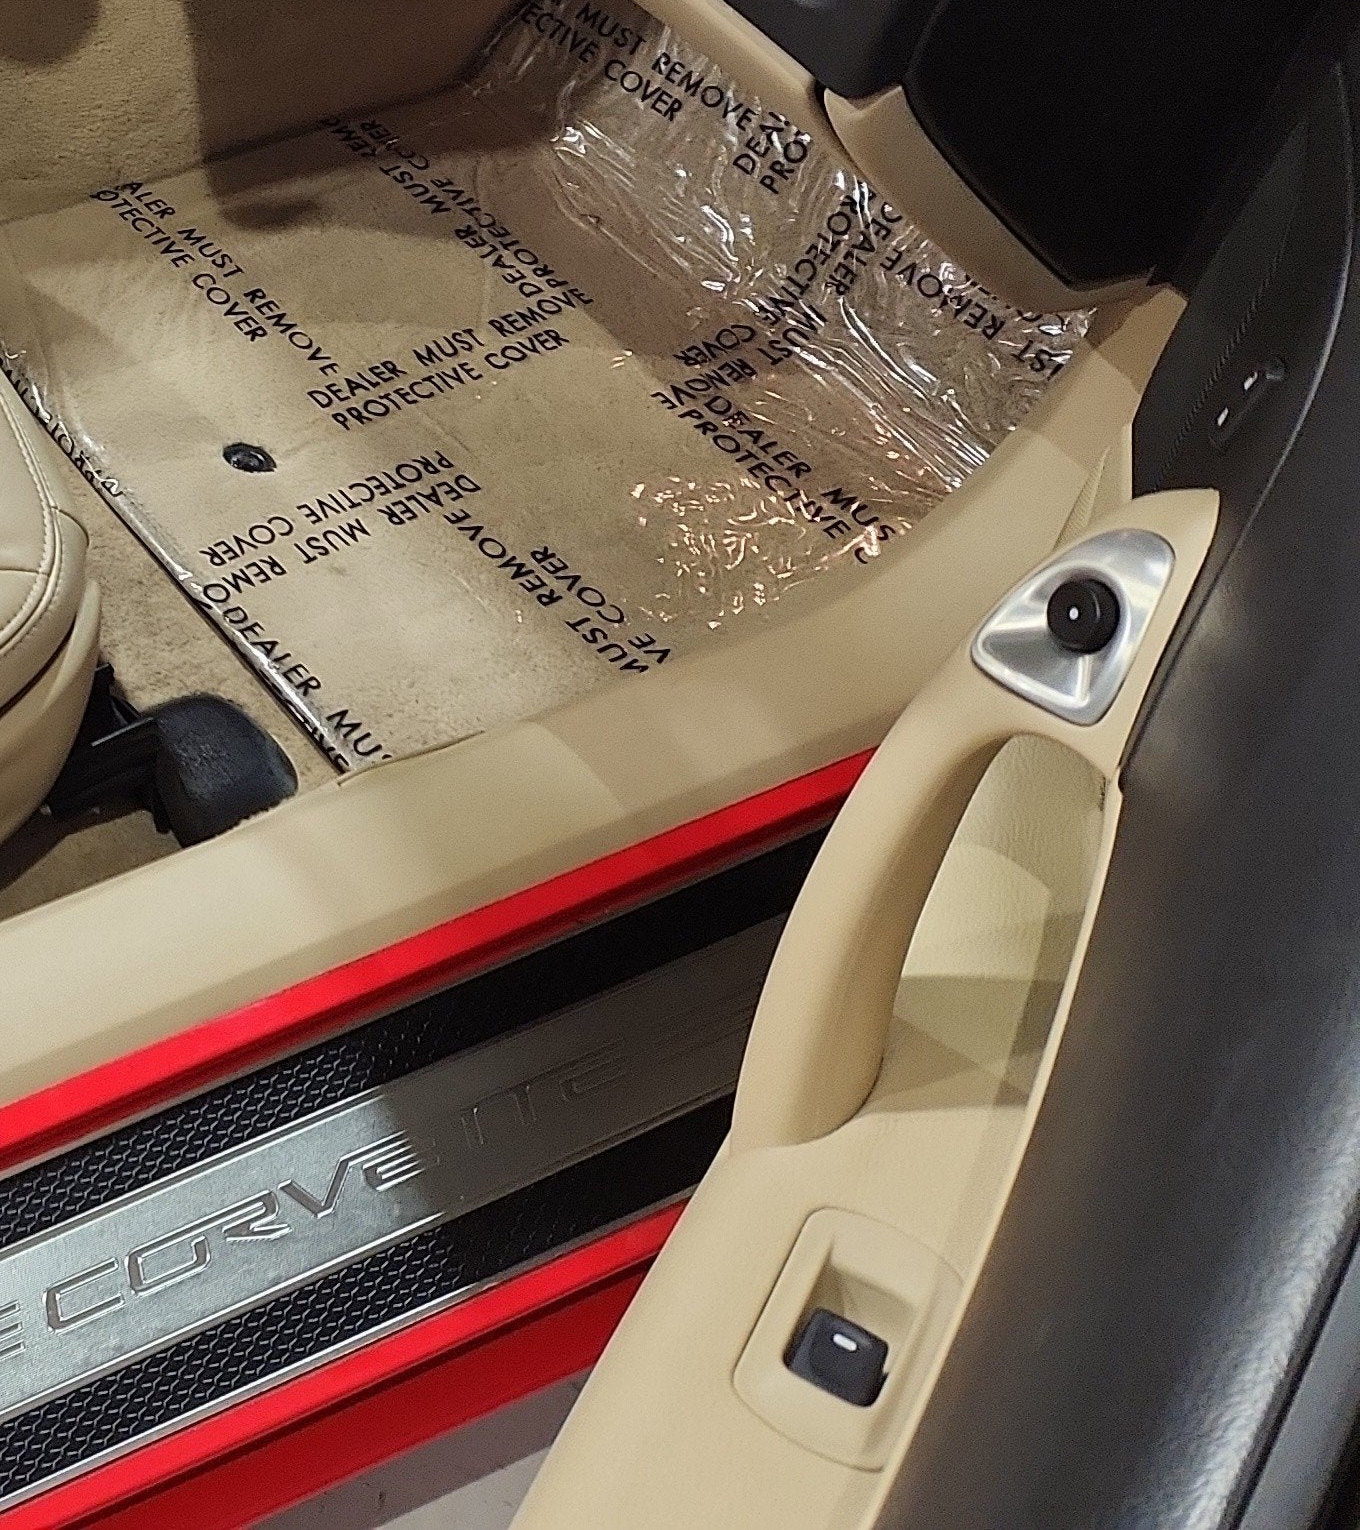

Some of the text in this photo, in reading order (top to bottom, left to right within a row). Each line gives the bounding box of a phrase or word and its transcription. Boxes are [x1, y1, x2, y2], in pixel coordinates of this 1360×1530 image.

[521, 1, 683, 122] ECTIVE COVER
[576, 1, 757, 132] MUST REMOVE
[379, 165, 452, 215] MUST
[430, 175, 569, 290] PROTECTIVE
[91, 189, 269, 343] OTECTIVE COVER
[118, 181, 340, 377] ALER MUST REMOVE
[454, 224, 544, 299] DEALER
[306, 287, 594, 409] DEALER MUST REMOVE
[331, 328, 570, 431] PROTECTIVE COVER
[199, 450, 455, 567] PROTECTIVE COVER
[705, 395, 896, 541] DEALER MUS
[198, 473, 482, 606] DEALER MUST REMO
[443, 508, 563, 607] REMOVE
[530, 546, 625, 624] COVER
[326, 709, 392, 760] MU
[43, 1033, 630, 1336] CORVETTE
